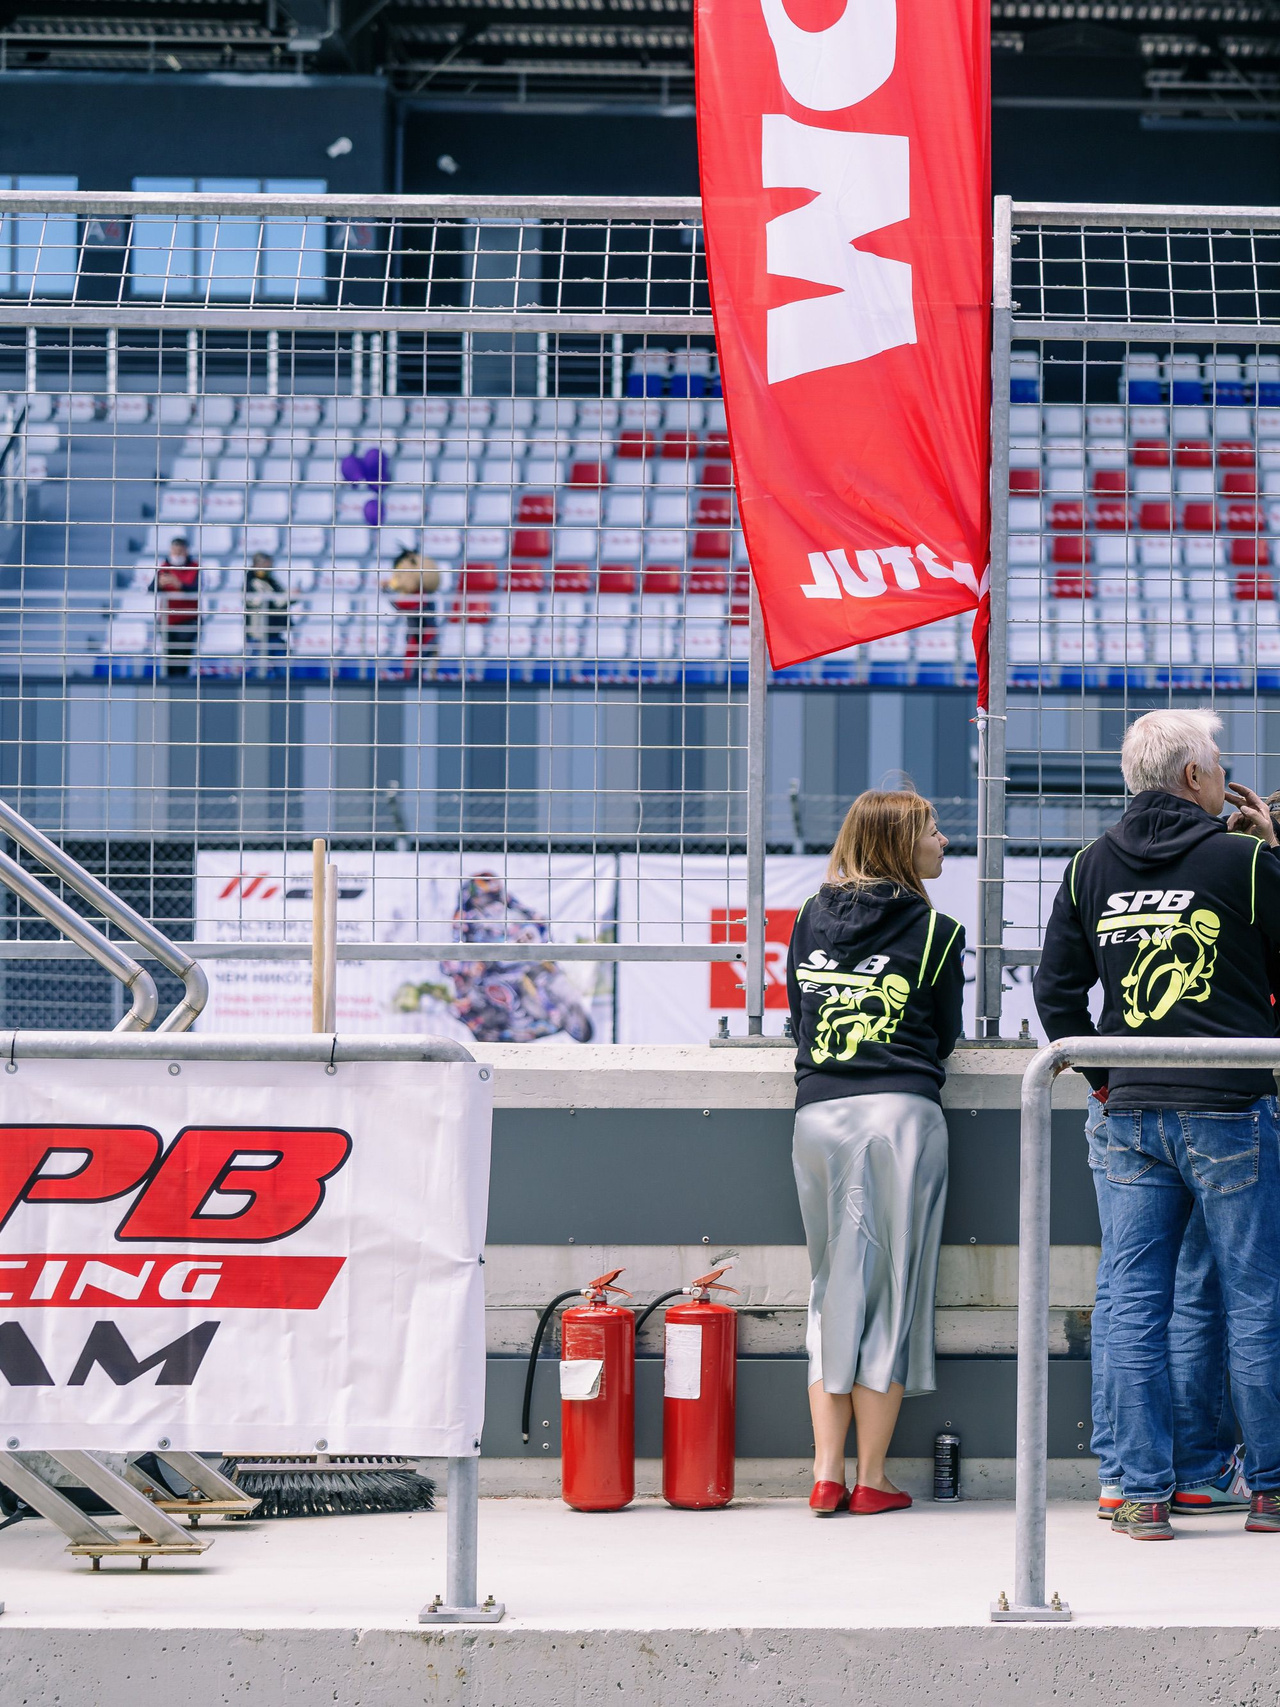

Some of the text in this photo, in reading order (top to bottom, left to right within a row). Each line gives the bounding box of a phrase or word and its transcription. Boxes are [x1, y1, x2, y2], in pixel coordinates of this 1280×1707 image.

[1101, 890, 1195, 917] SPB
[1097, 927, 1174, 947] TEAM
[0, 1123, 353, 1243] PB
